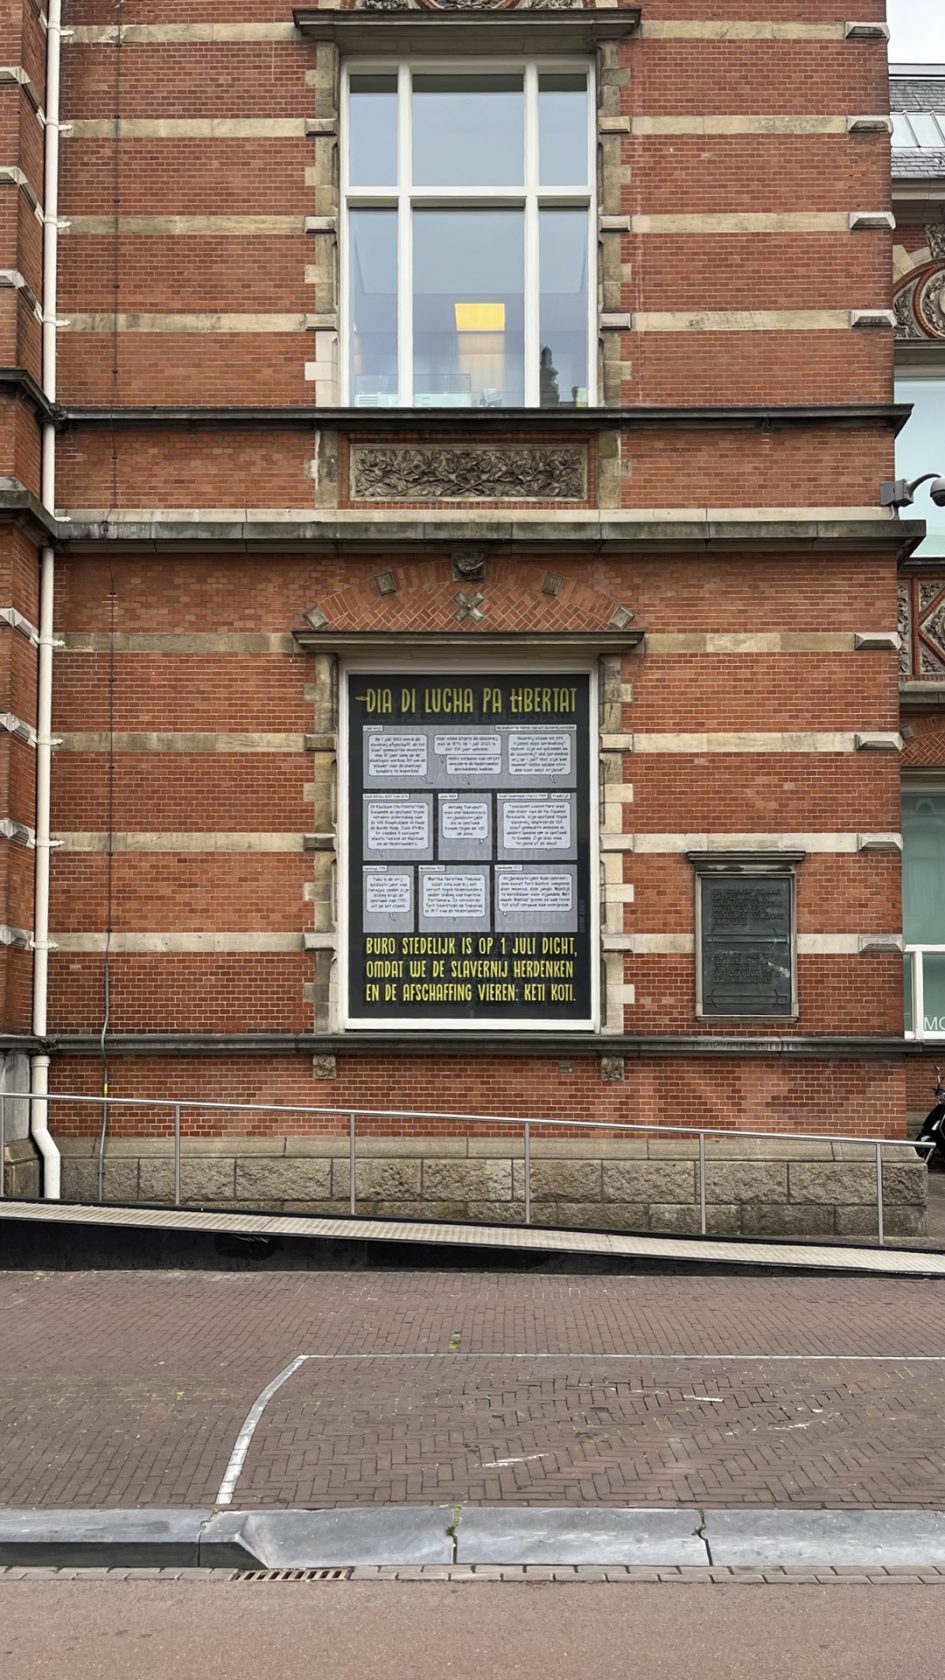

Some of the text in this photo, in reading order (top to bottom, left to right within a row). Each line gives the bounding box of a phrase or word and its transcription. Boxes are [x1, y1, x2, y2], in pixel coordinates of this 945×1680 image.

[366, 687, 393, 713] DIA
[401, 688, 416, 713] DI
[424, 687, 474, 713] LUCHA
[482, 687, 503, 713] PA
[365, 936, 578, 958] BURO STEDELIJK IS OP 1 JULI DICHT,
[365, 960, 574, 979] OMDAT WE DE SLAVERNIJ HERDENKEN
[365, 983, 577, 1002] EN DE AFSCHAFFING VIEREN: KETI KOTI.
